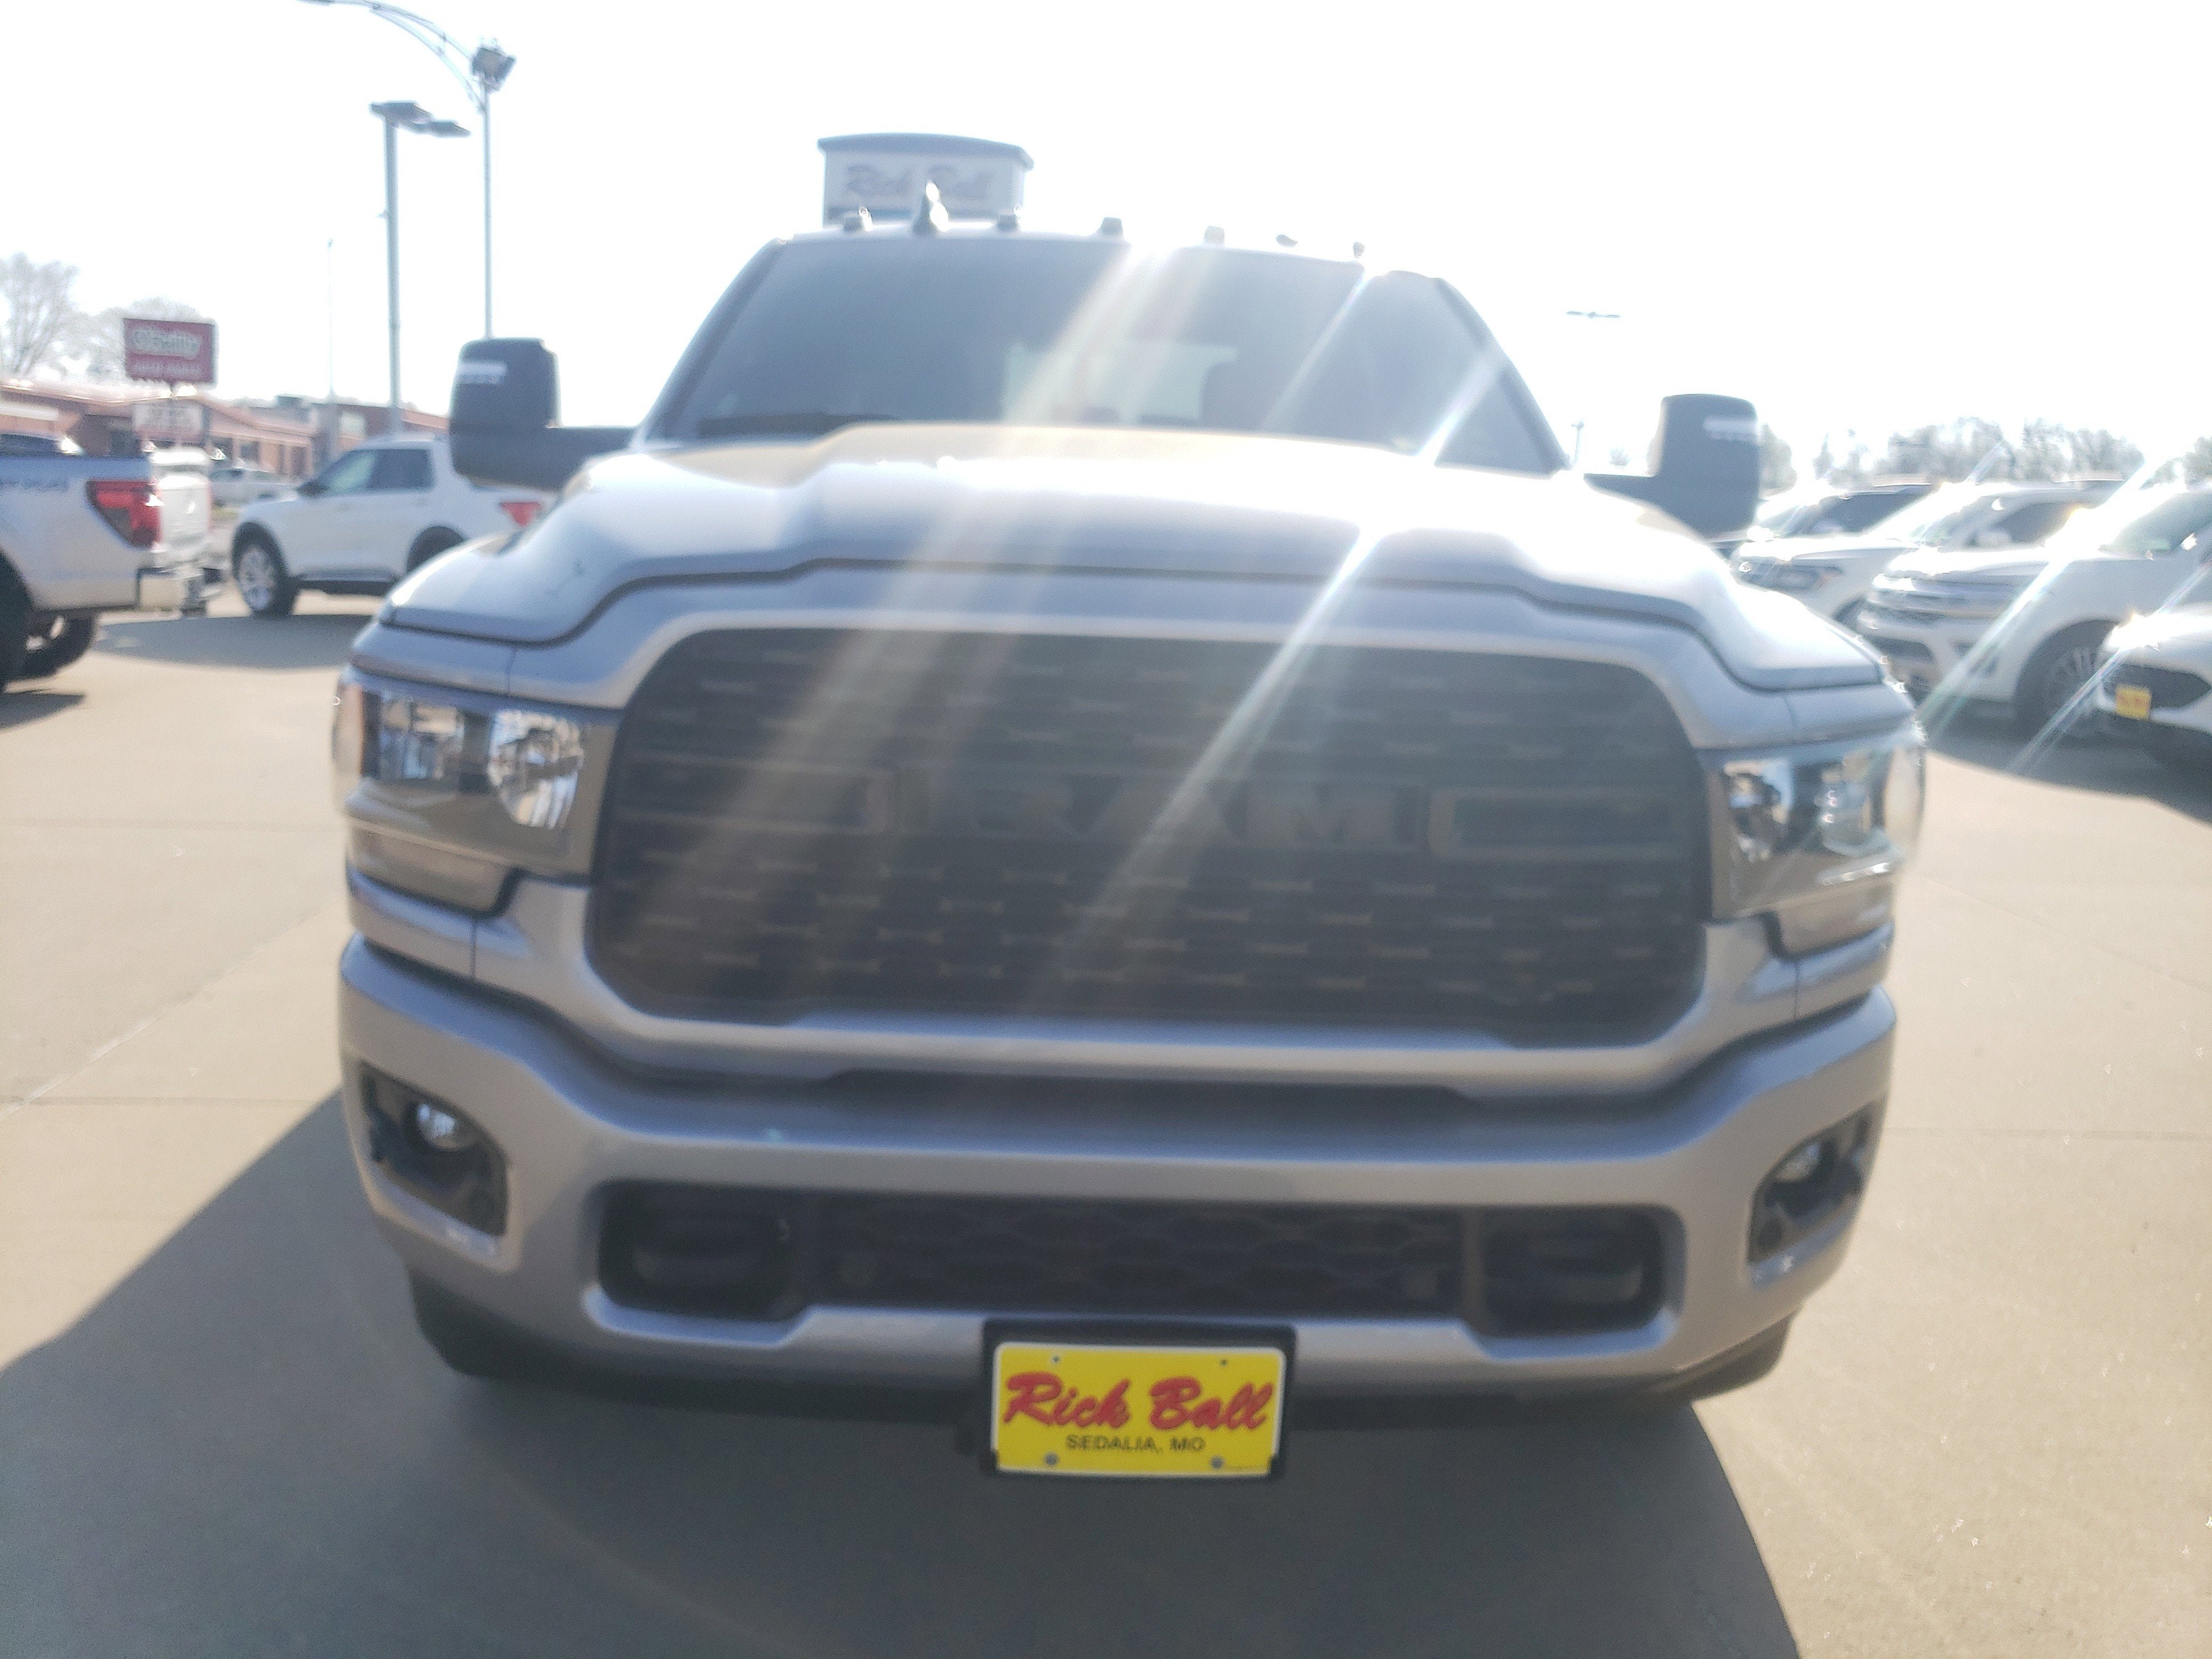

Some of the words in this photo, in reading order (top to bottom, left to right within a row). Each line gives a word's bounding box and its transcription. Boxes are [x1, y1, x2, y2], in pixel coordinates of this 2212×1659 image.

[937, 772, 1395, 846] RAM
[1003, 1371, 1132, 1428] Rick
[1149, 1376, 1274, 1430] Ball
[1065, 1435, 1163, 1454] SEDALIA,
[1170, 1436, 1205, 1451] MO
